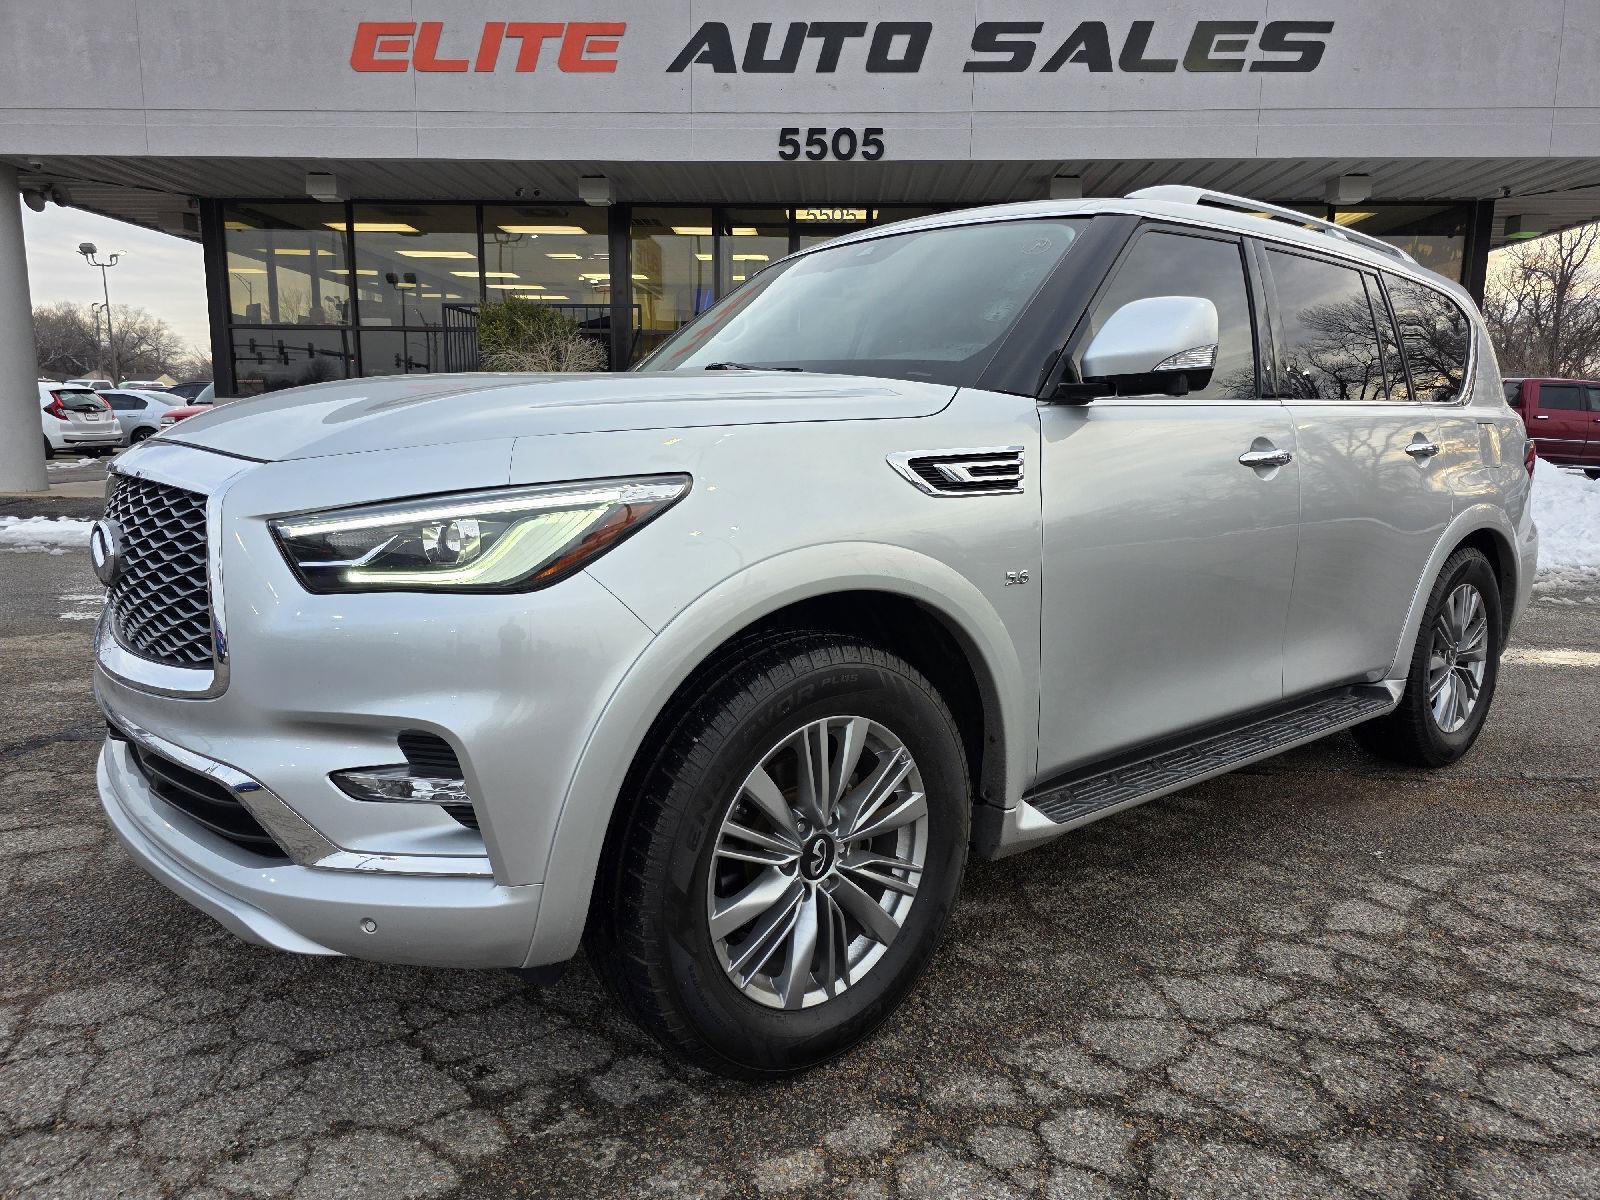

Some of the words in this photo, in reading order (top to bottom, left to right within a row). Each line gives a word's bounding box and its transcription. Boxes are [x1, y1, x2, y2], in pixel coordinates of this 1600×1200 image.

[351, 22, 624, 72] ELITE
[667, 22, 932, 73] AUTO
[964, 21, 1334, 72] SALES
[779, 128, 884, 161] 5505
[806, 207, 857, 223] 5505
[822, 674, 859, 689] PLUS
